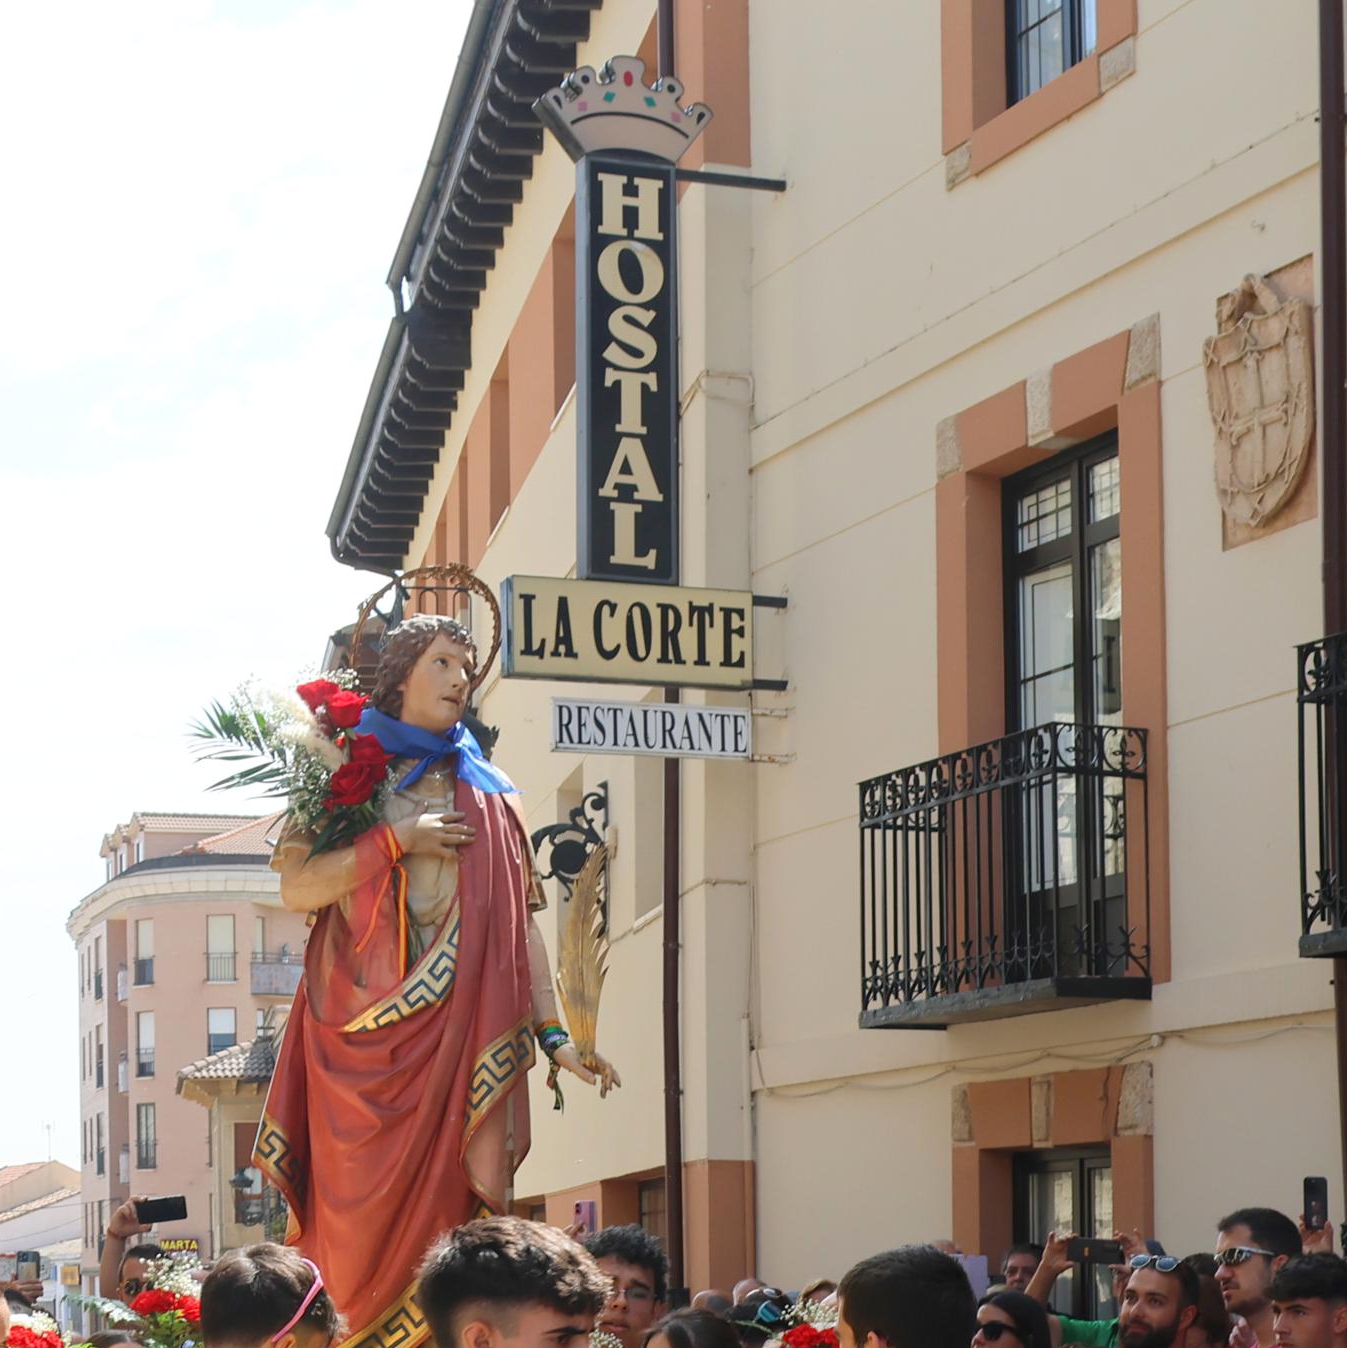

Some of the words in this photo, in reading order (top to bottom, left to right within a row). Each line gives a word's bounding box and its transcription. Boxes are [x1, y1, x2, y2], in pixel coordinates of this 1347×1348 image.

[597, 172, 665, 571] HOSTAL
[519, 593, 579, 659] LA
[592, 599, 746, 670] CORTE
[556, 703, 748, 755] RESTAURANTE
[161, 1240, 198, 1250] MARTA
